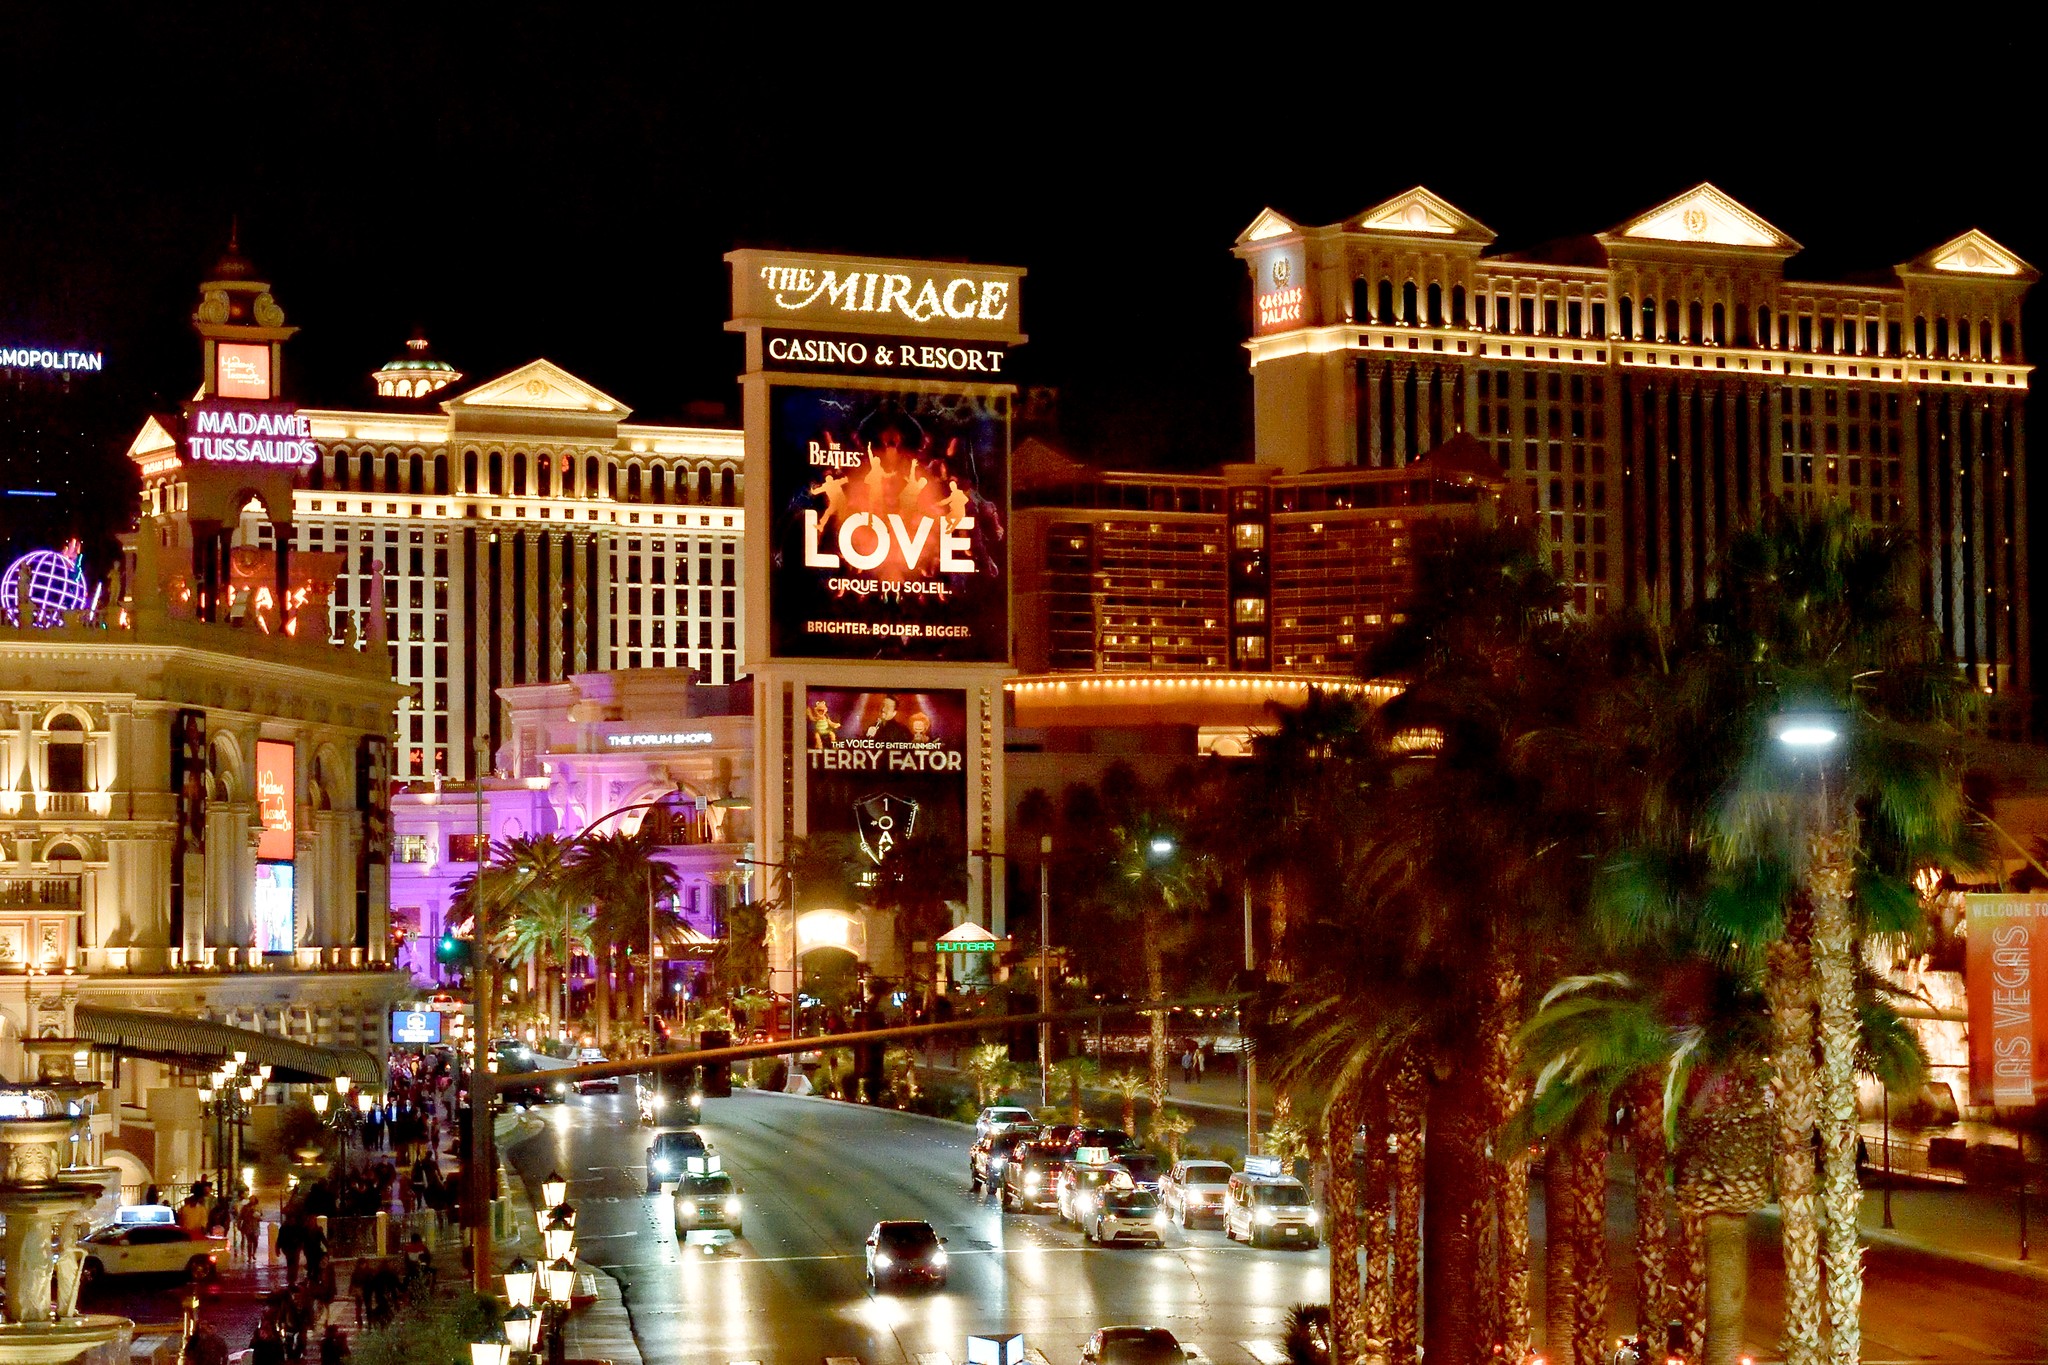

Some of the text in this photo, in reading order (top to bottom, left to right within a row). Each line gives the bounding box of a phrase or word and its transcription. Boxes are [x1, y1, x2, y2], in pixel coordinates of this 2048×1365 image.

[761, 266, 1009, 322] THE MIRAGE
[1259, 287, 1302, 311] CAESARS
[1261, 303, 1300, 326] PALACE
[769, 338, 1003, 372] CASINO & RESORT
[197, 411, 310, 438] MADAME
[804, 508, 976, 573] LOVE
[828, 578, 878, 595] CIRQUE
[881, 580, 900, 592] DU
[807, 620, 971, 637] BRIGHTER. BOLDER. BIGGER.
[608, 732, 713, 746] THE FORUM SHOPS
[846, 739, 875, 749] VOICE
[875, 741, 885, 749] OF
[886, 742, 942, 750] ENTERTAINMENT
[807, 748, 962, 771] TERRY FATOR
[1972, 902, 2048, 918] WELCOME TO
[935, 941, 995, 952] HUMBAR
[1992, 924, 2033, 1098] LAS VEGAS
